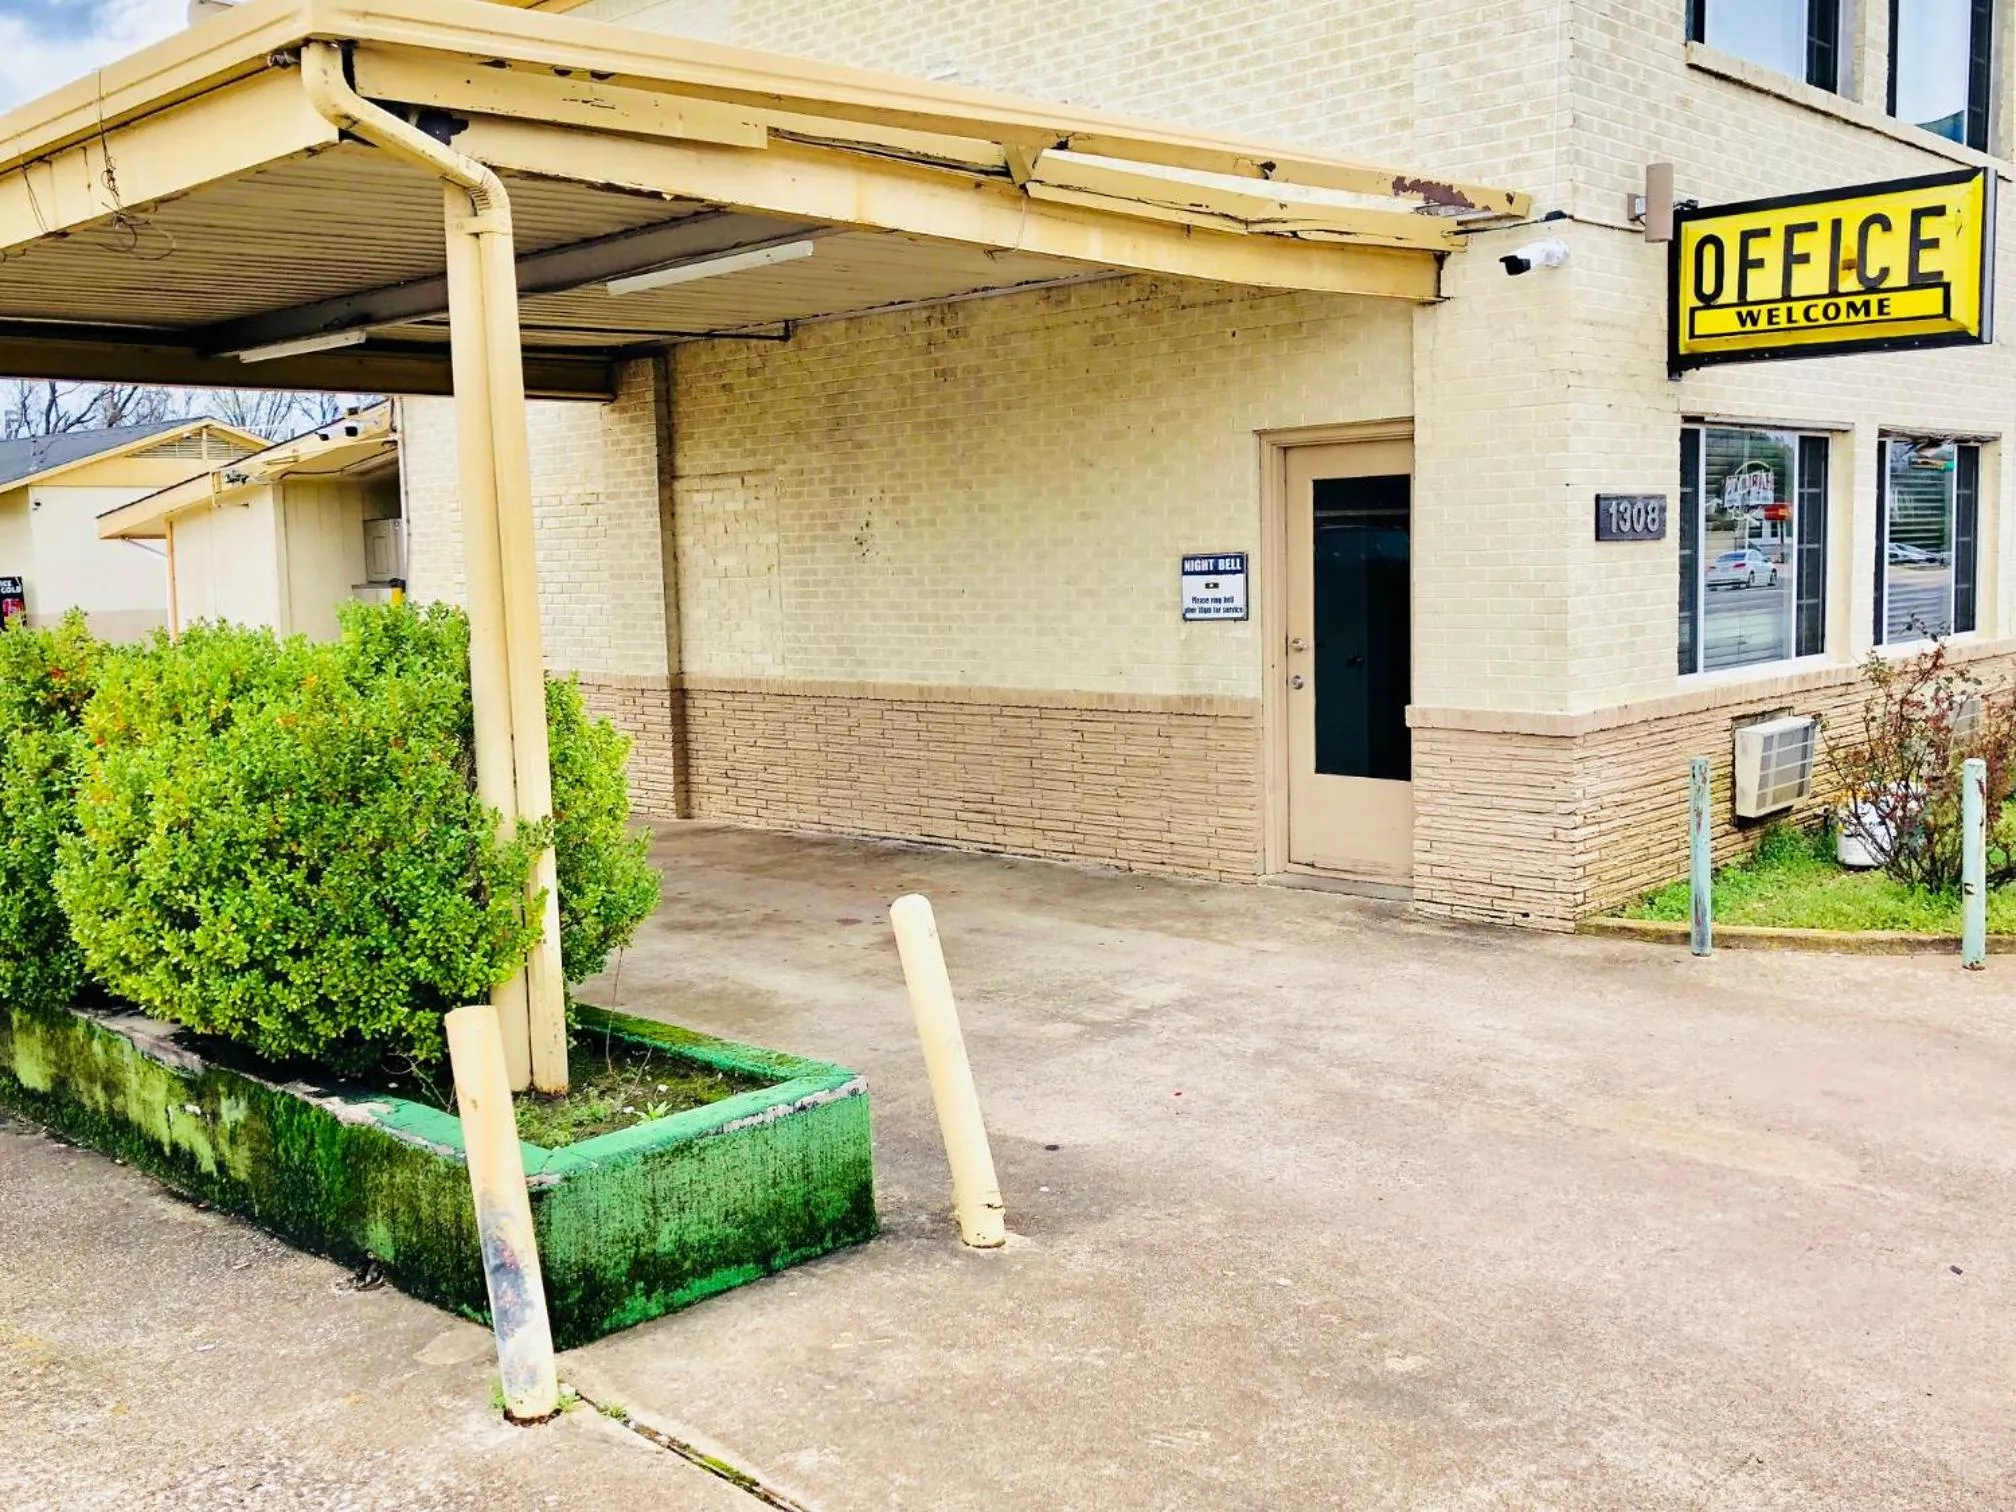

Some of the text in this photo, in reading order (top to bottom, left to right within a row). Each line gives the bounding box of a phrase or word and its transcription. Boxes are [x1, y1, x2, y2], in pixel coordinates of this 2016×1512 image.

[1694, 204, 1947, 305] OFFICE
[1736, 298, 1891, 328] WELCOME
[1609, 500, 1660, 533] 1308
[1184, 558, 1241, 572] NIGHT BELL
[1192, 596, 1209, 604] Please
